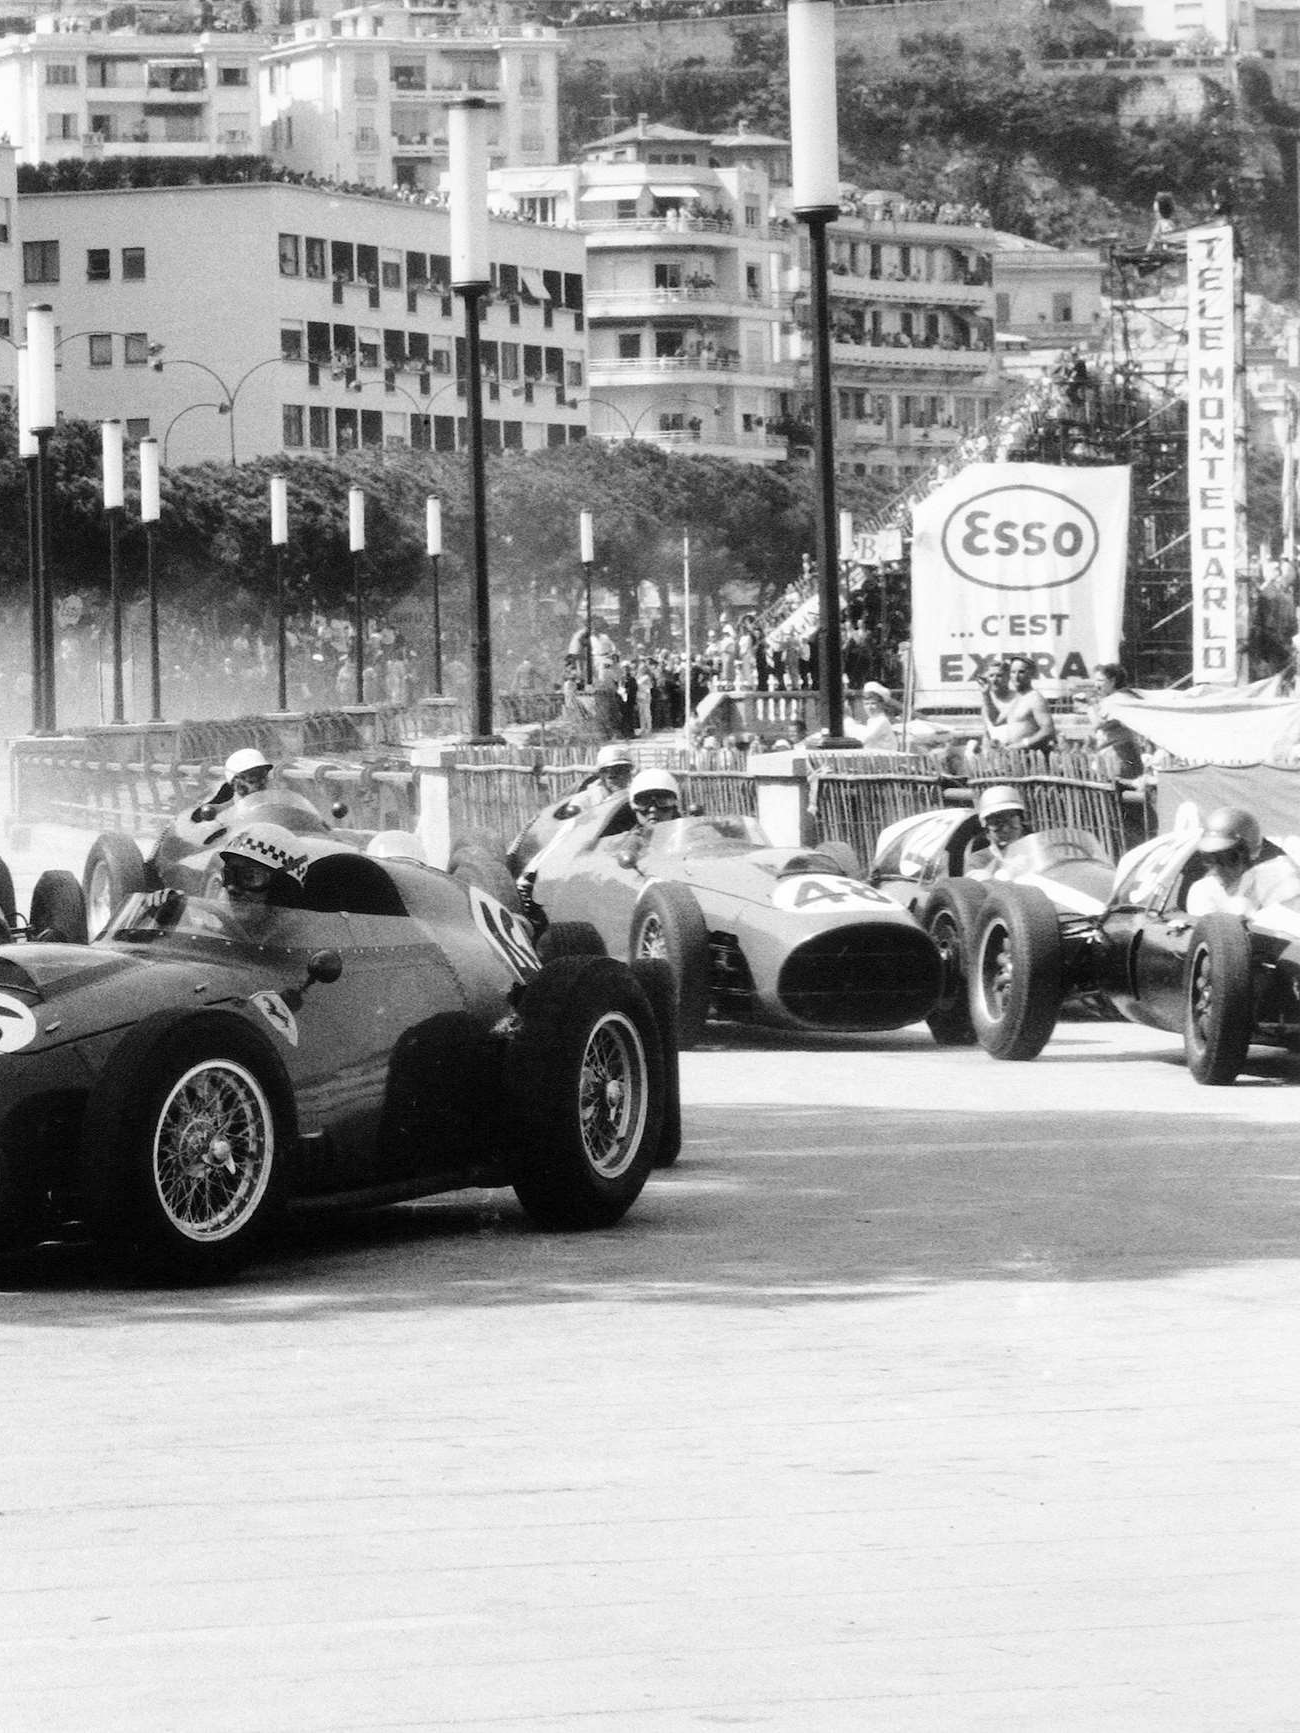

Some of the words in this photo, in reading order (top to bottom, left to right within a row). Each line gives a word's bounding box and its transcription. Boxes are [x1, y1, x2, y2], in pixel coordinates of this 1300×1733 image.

[1198, 237, 1224, 350] TELE
[1199, 367, 1225, 510] MONTE
[1201, 527, 1227, 669] CARLO
